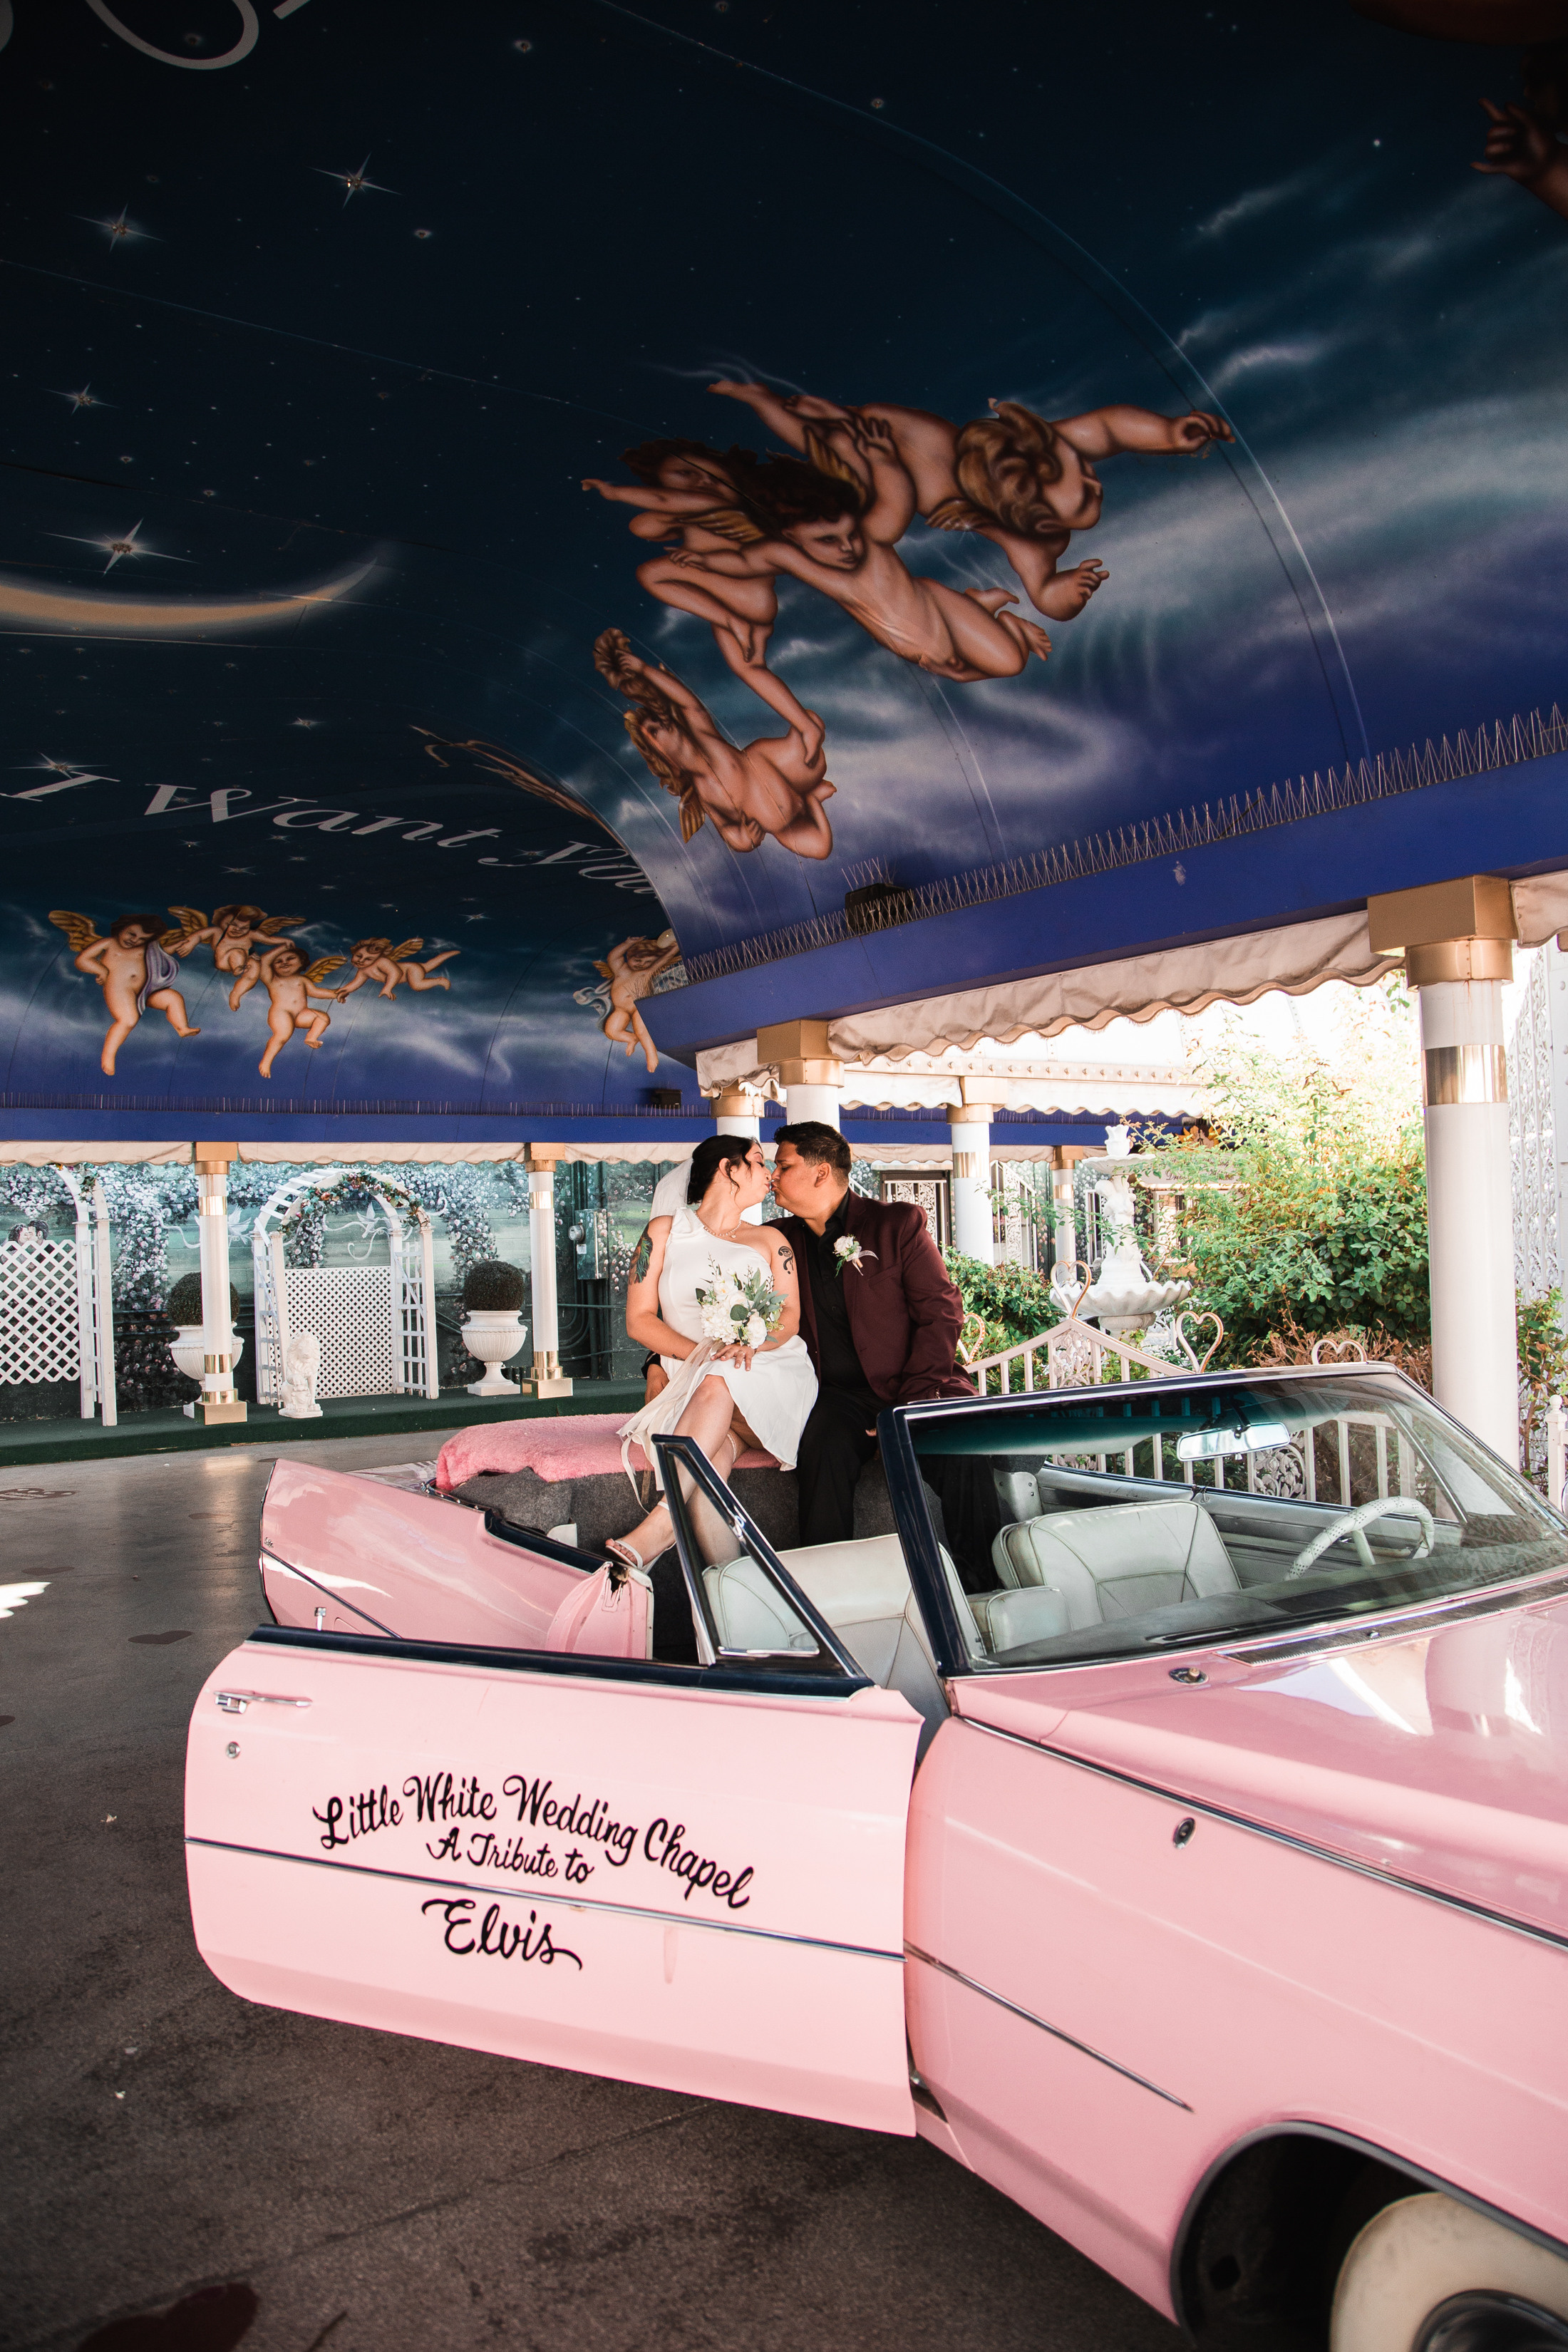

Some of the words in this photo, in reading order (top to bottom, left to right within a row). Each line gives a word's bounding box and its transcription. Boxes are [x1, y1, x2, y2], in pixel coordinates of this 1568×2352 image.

[144, 783, 503, 847] Want
[313, 1785, 403, 1849] Little
[403, 1772, 497, 1822] White
[502, 1775, 639, 1867] Wedding
[644, 1818, 754, 1909] Chapel
[425, 1827, 462, 1861] A
[467, 1833, 558, 1877] Tribute
[564, 1847, 595, 1884] to
[421, 1899, 583, 1971] Elvis
